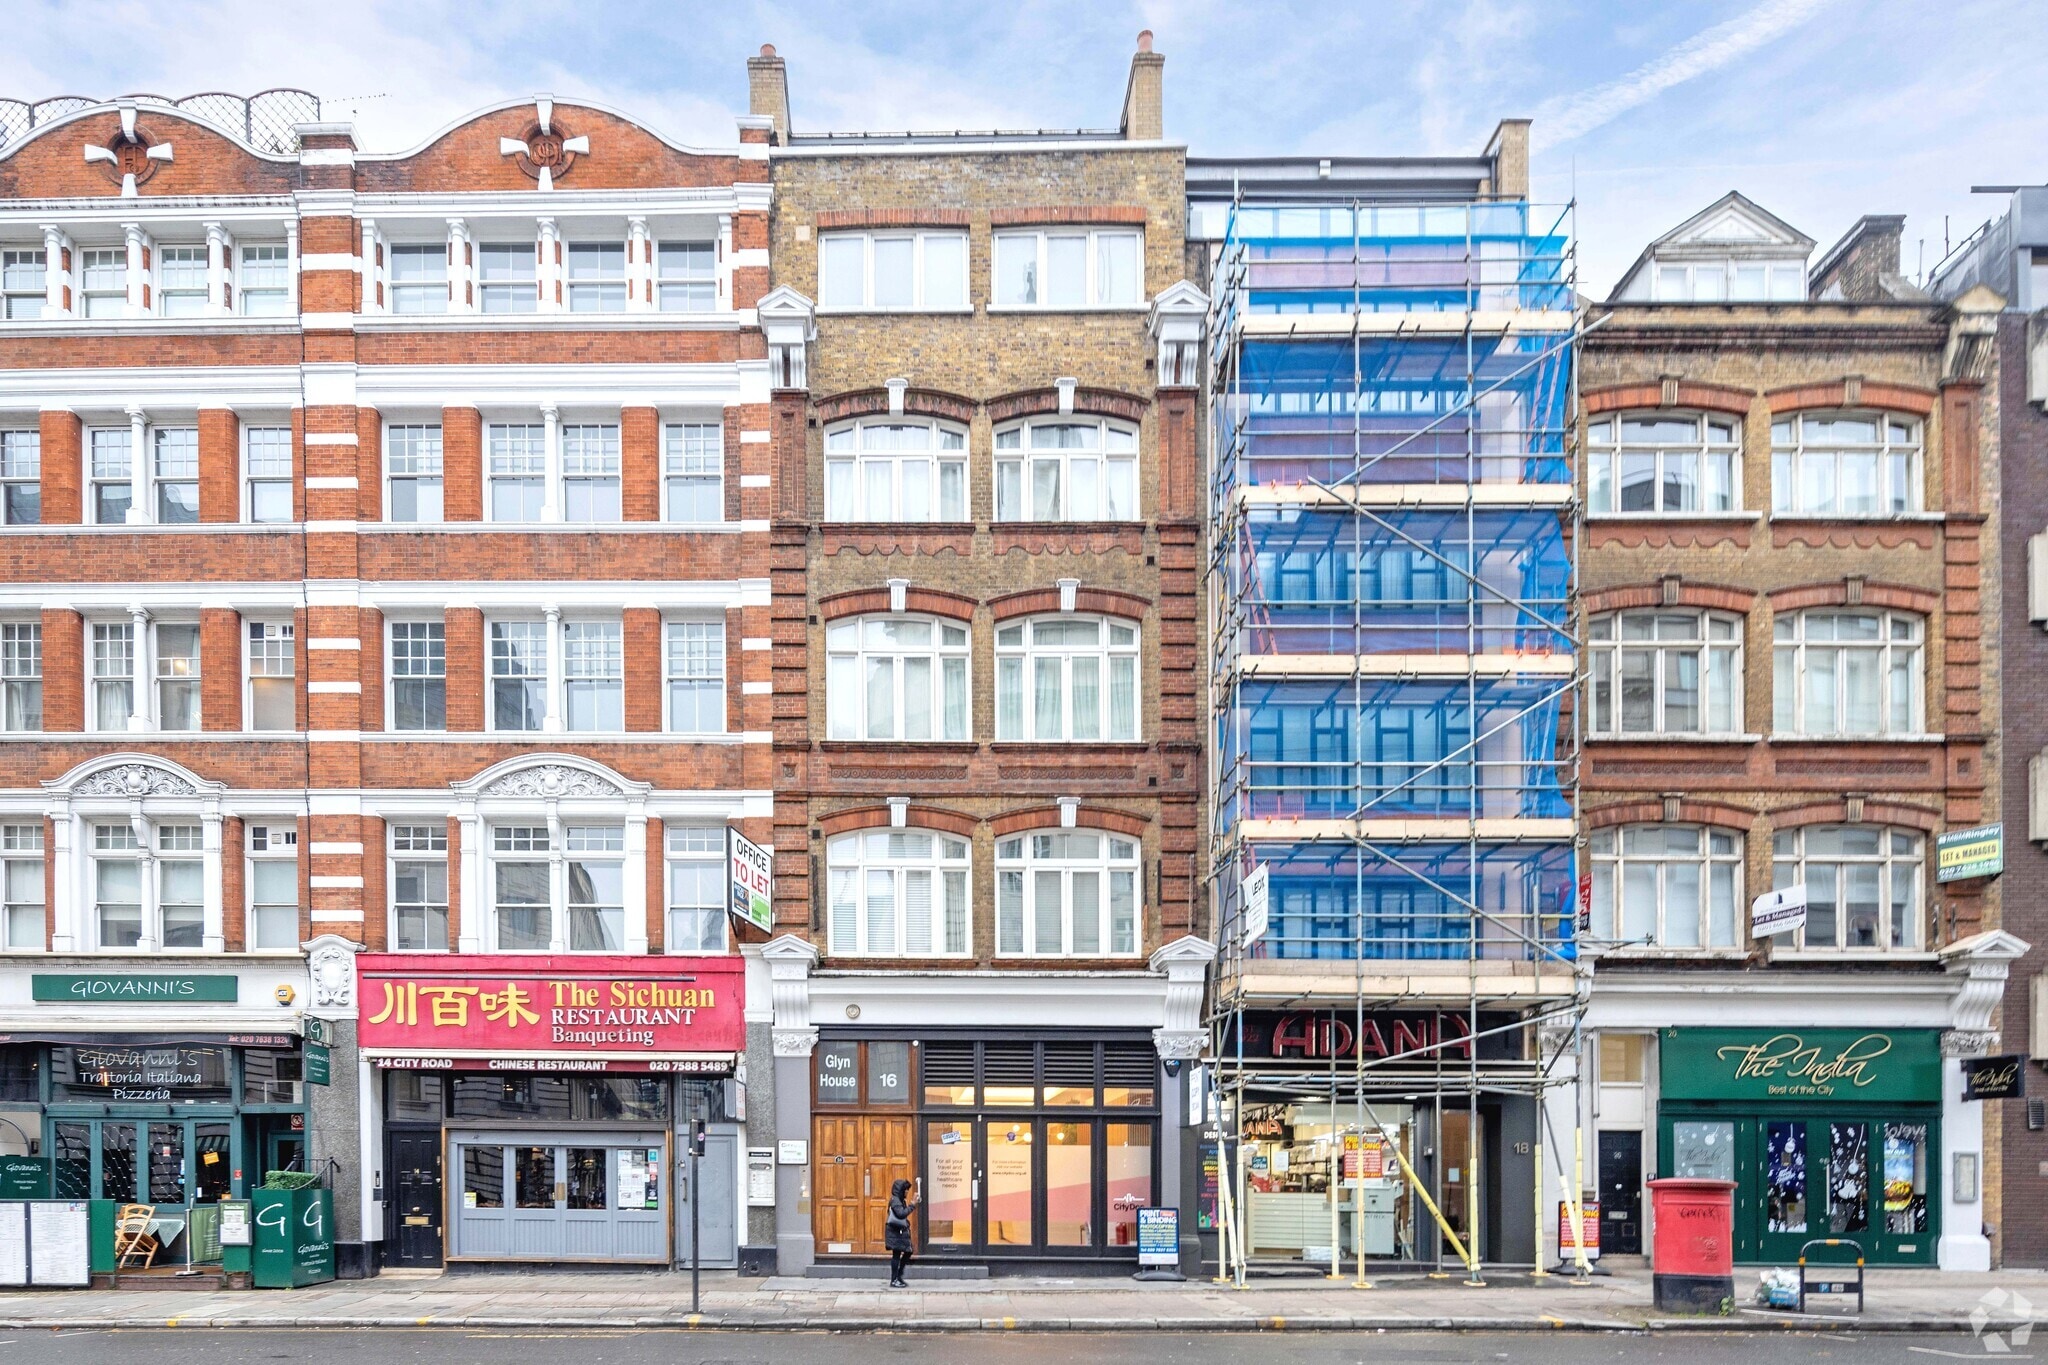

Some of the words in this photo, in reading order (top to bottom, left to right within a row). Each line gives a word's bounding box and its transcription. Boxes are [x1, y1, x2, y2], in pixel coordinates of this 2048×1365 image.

[736, 838, 767, 873] OFFICE
[733, 857, 748, 883] TO
[751, 870, 769, 897] LET
[1754, 914, 1765, 925] Let
[1771, 907, 1801, 920] Managed
[71, 981, 195, 997] GIOVANNI'S
[549, 982, 600, 1007] The
[609, 982, 716, 1009] Sichuan
[368, 981, 541, 1028] 川百味
[551, 1008, 695, 1025] RESTAURANT
[310, 1021, 320, 1039] G
[551, 1027, 654, 1046] Banqueting
[1272, 1008, 1473, 1058] ADANA
[1667, 1029, 1678, 1039] 20
[79, 1047, 199, 1067] Giovanni's
[377, 1058, 390, 1067] 14
[393, 1058, 417, 1068] CITY
[420, 1059, 453, 1069] ROAD
[825, 1054, 851, 1070] Glyn
[1717, 1033, 1803, 1080] The
[1786, 1033, 1892, 1087] India
[488, 1060, 536, 1071] CHINESE
[538, 1060, 608, 1072] RESTAURANT
[649, 1062, 669, 1072] 020
[672, 1062, 699, 1073] 7588
[700, 1062, 728, 1073] 5489
[80, 1070, 142, 1083] Trattoria
[147, 1071, 201, 1083] Italiana
[819, 1074, 856, 1088] House
[879, 1074, 897, 1088] 16
[112, 1087, 171, 1100] Pizzeria
[1768, 1085, 1787, 1095] Best
[1789, 1085, 1799, 1095] of
[1799, 1085, 1815, 1095] the
[1817, 1085, 1835, 1096] City
[1203, 1131, 1228, 1140] DESIN
[1513, 1142, 1529, 1154] 18
[256, 1203, 286, 1237] G
[303, 1201, 322, 1236] G
[1140, 1209, 1160, 1217] PRINT
